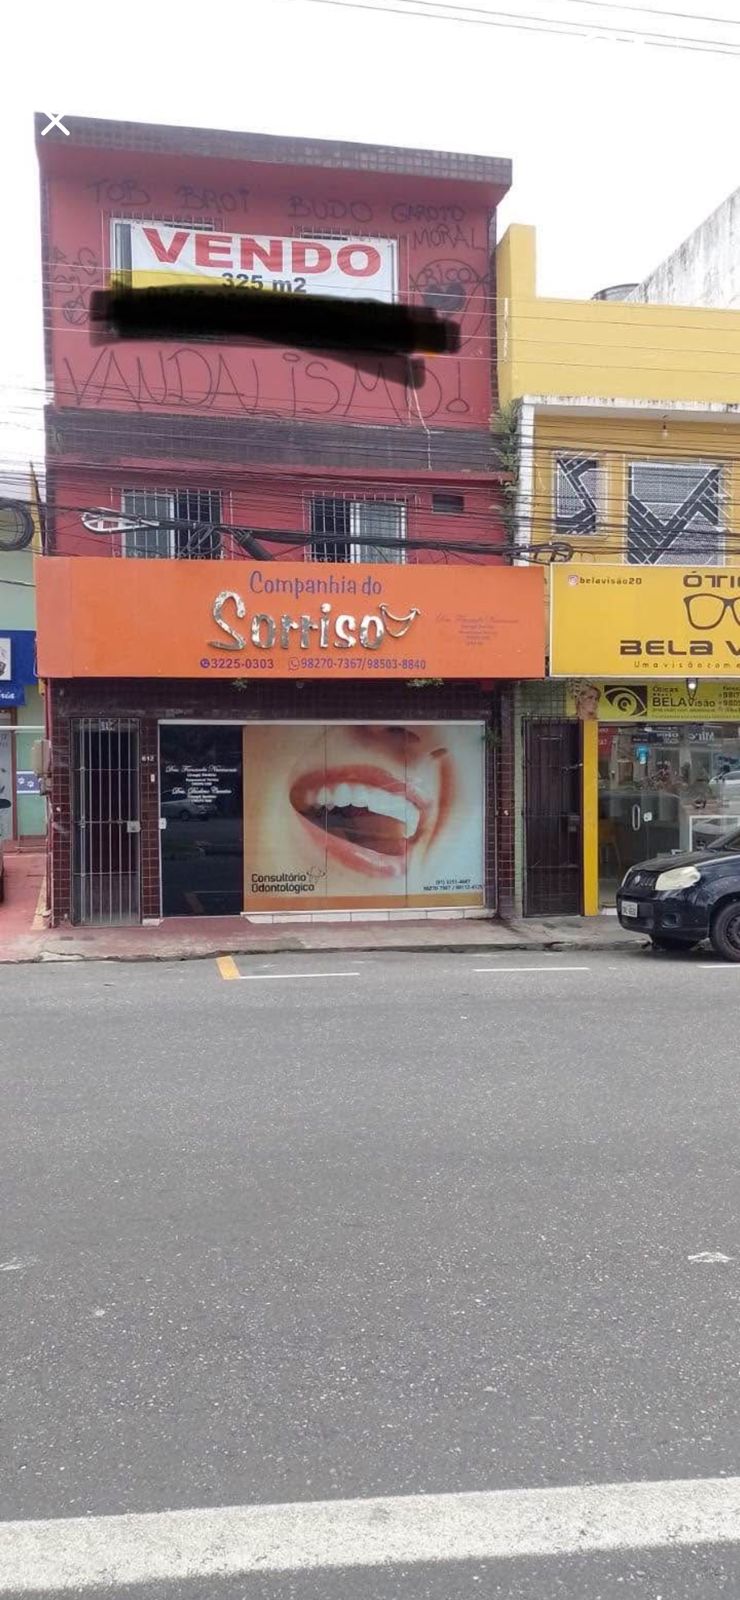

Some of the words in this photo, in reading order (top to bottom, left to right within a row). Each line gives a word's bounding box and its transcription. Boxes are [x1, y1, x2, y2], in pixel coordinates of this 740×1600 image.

[412, 223, 486, 250] MORAL
[143, 227, 382, 278] VENDO
[221, 271, 264, 291] 325
[272, 276, 307, 294] m2
[250, 570, 357, 599] Companhia
[361, 575, 382, 596] do
[208, 590, 385, 650] Sorriso
[211, 658, 274, 669] 3225-0303
[300, 657, 427, 671] 98270-7367/98503-8840
[251, 871, 307, 883] Consultório
[251, 882, 315, 895] Odontológico
